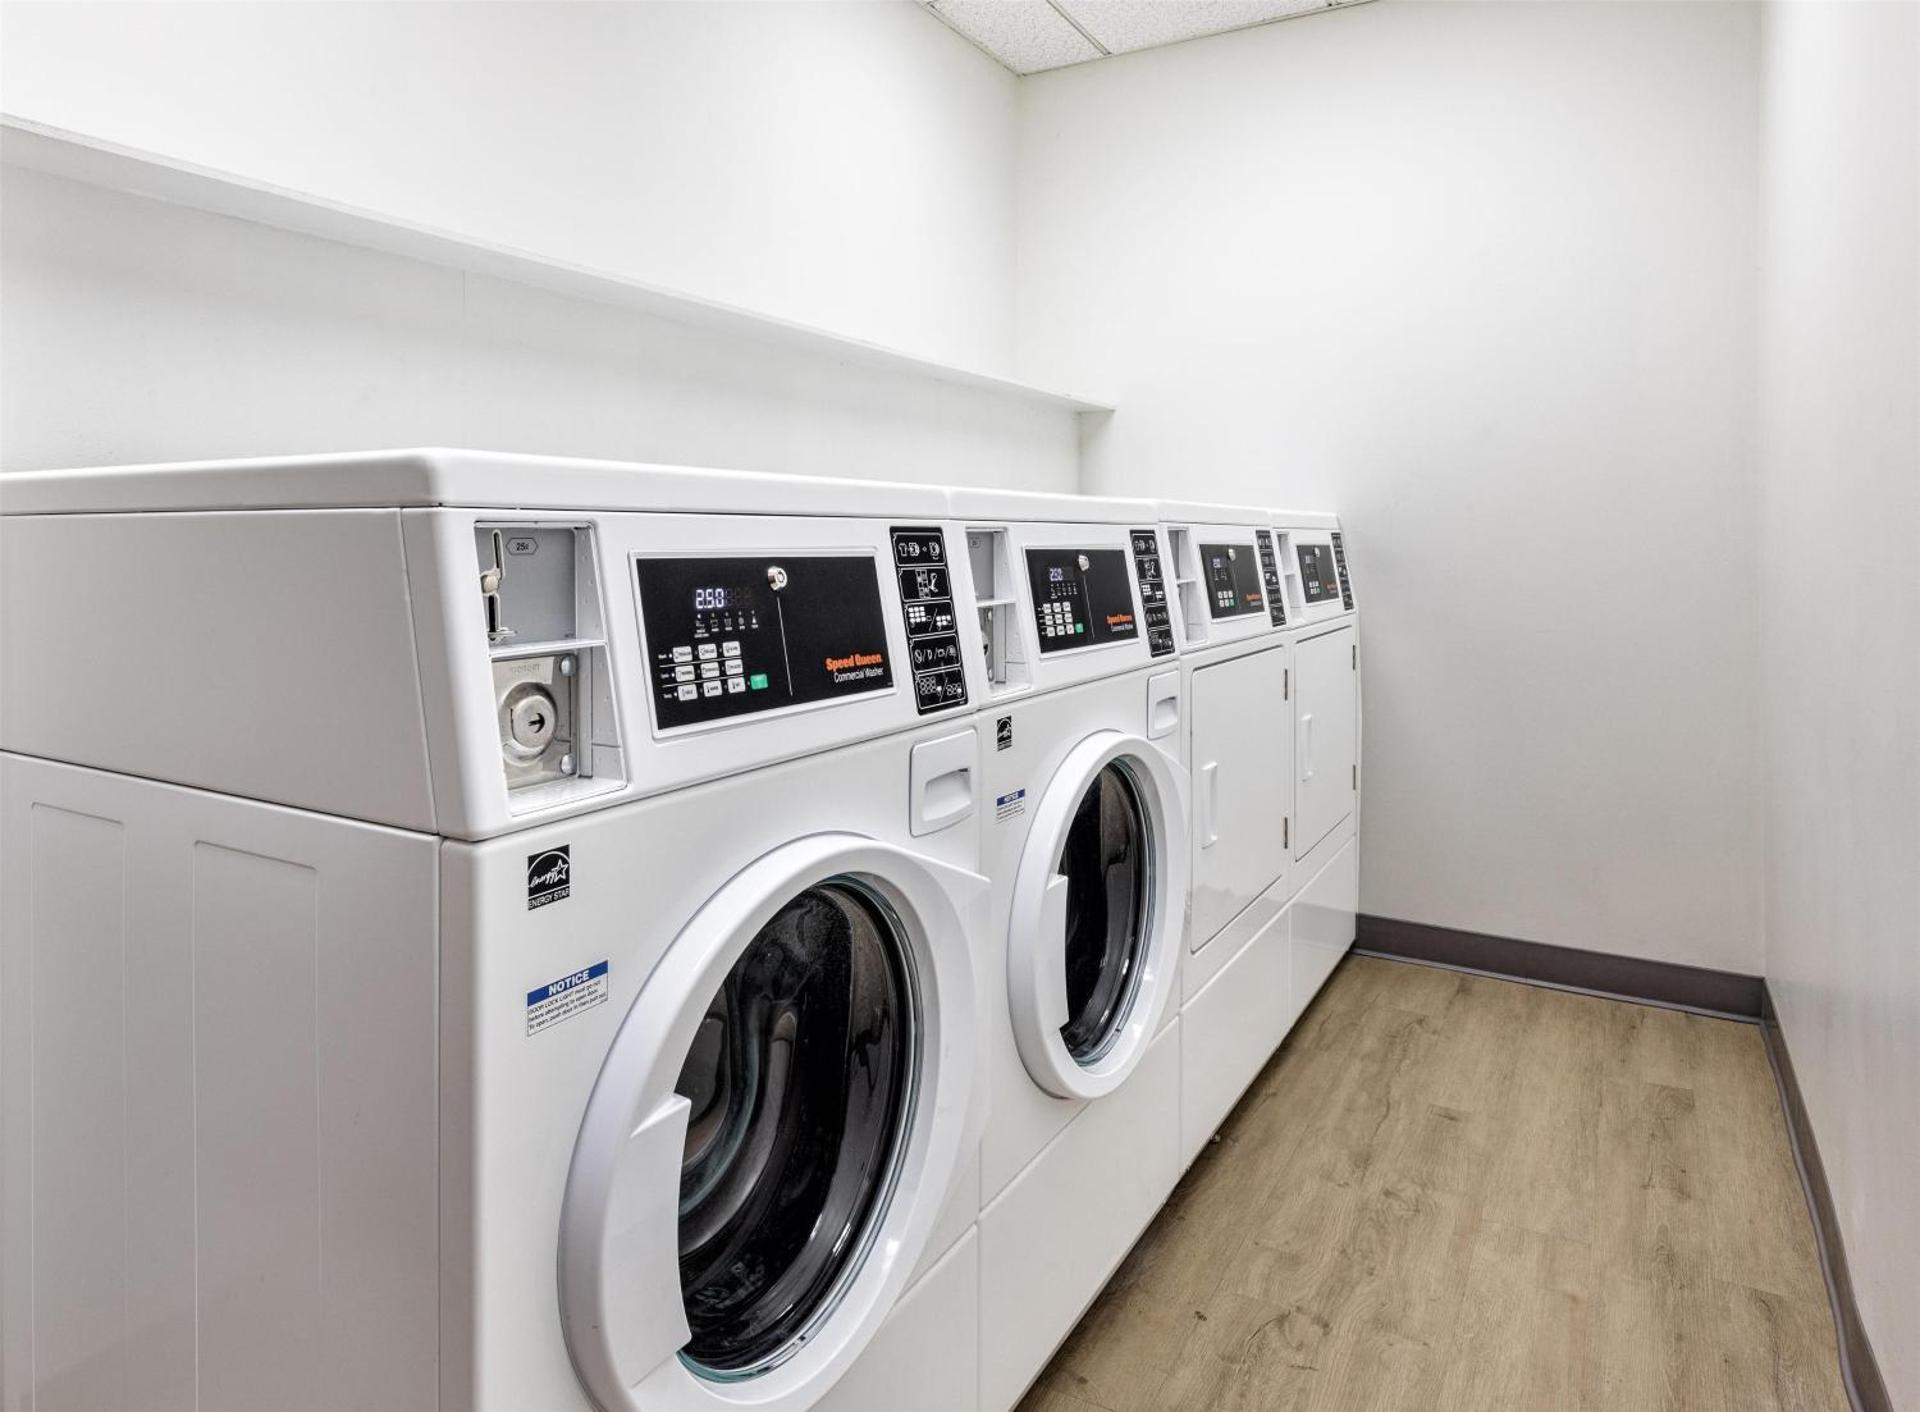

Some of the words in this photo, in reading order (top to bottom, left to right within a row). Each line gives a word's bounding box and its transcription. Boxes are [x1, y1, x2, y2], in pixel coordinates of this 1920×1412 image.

[825, 654, 855, 672] Speed
[855, 653, 881, 666] Queen
[833, 669, 865, 683] Commercial
[865, 666, 884, 678] Washer
[529, 894, 553, 909] ENERGY
[553, 887, 570, 901] STAR
[548, 970, 590, 996] NOTICE
